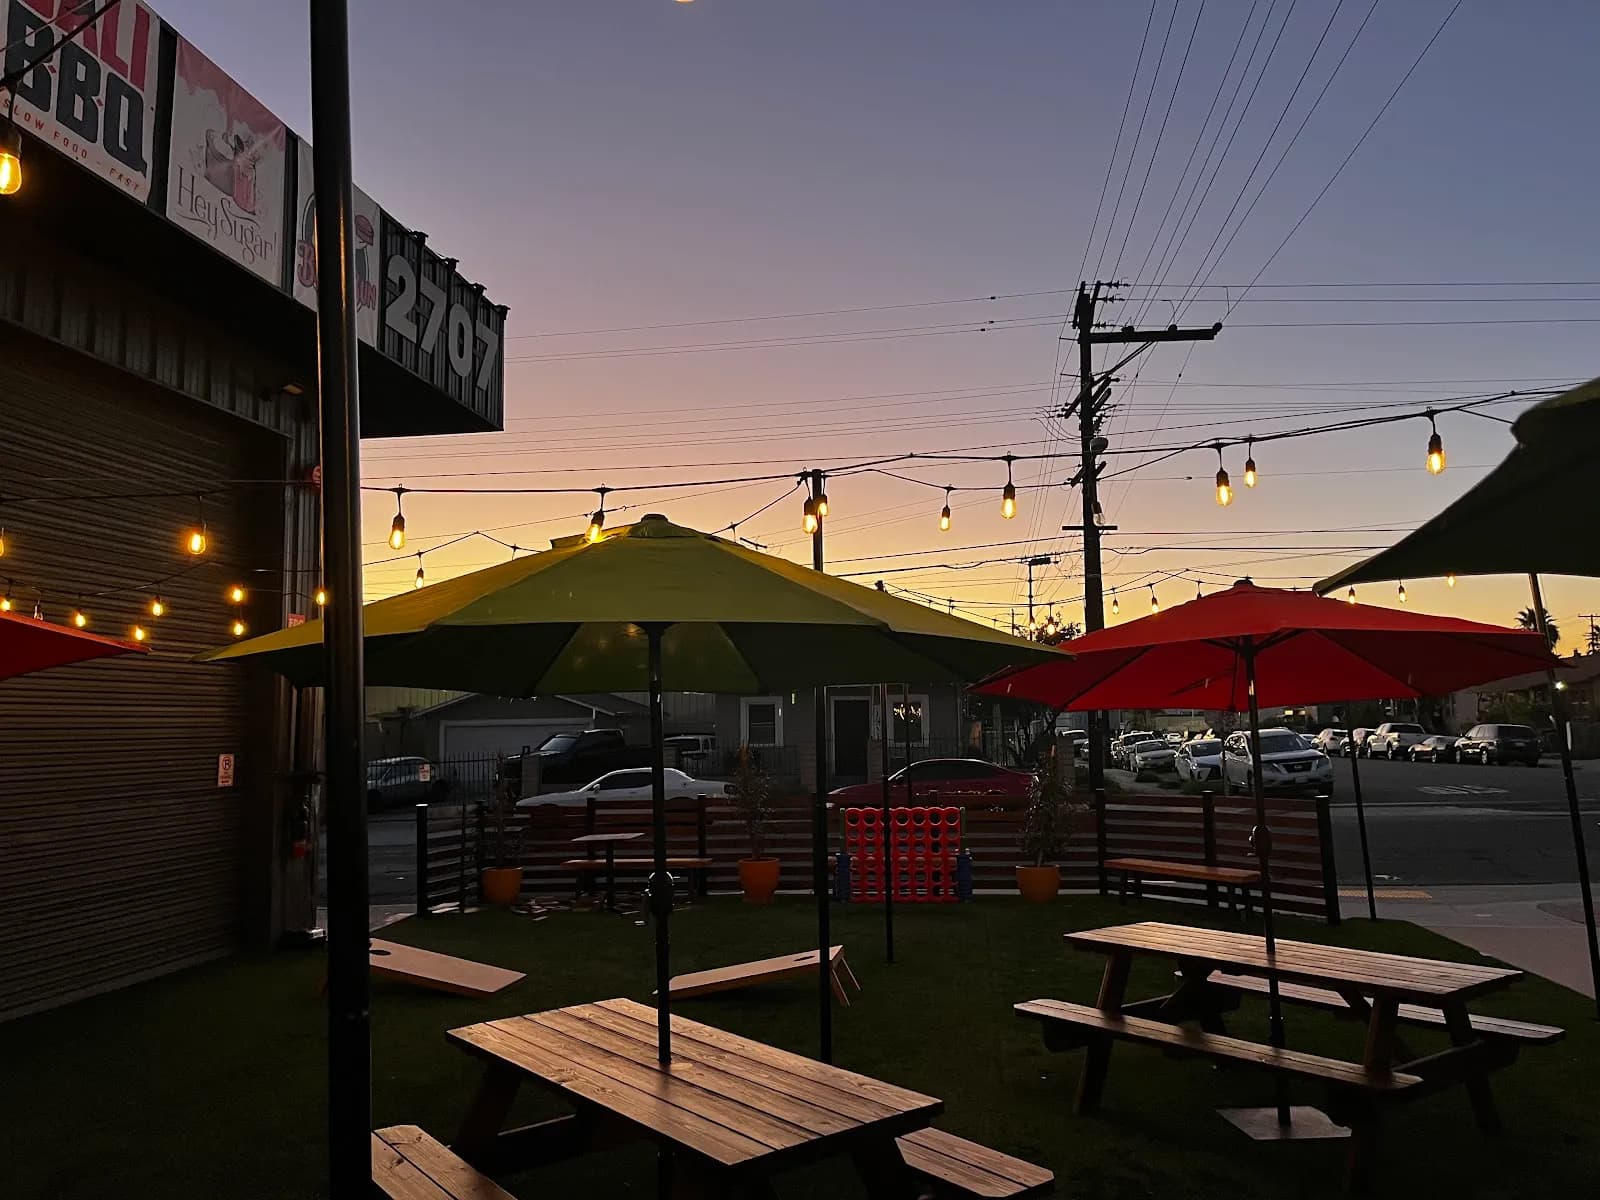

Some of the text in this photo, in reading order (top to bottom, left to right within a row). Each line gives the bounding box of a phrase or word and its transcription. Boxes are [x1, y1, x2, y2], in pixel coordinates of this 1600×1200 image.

[3, 98, 45, 131] SLOW
[53, 131, 88, 160] FOOD
[5, 0, 147, 177] BBQ
[176, 166, 218, 240] Hey
[385, 254, 499, 391] 2707
